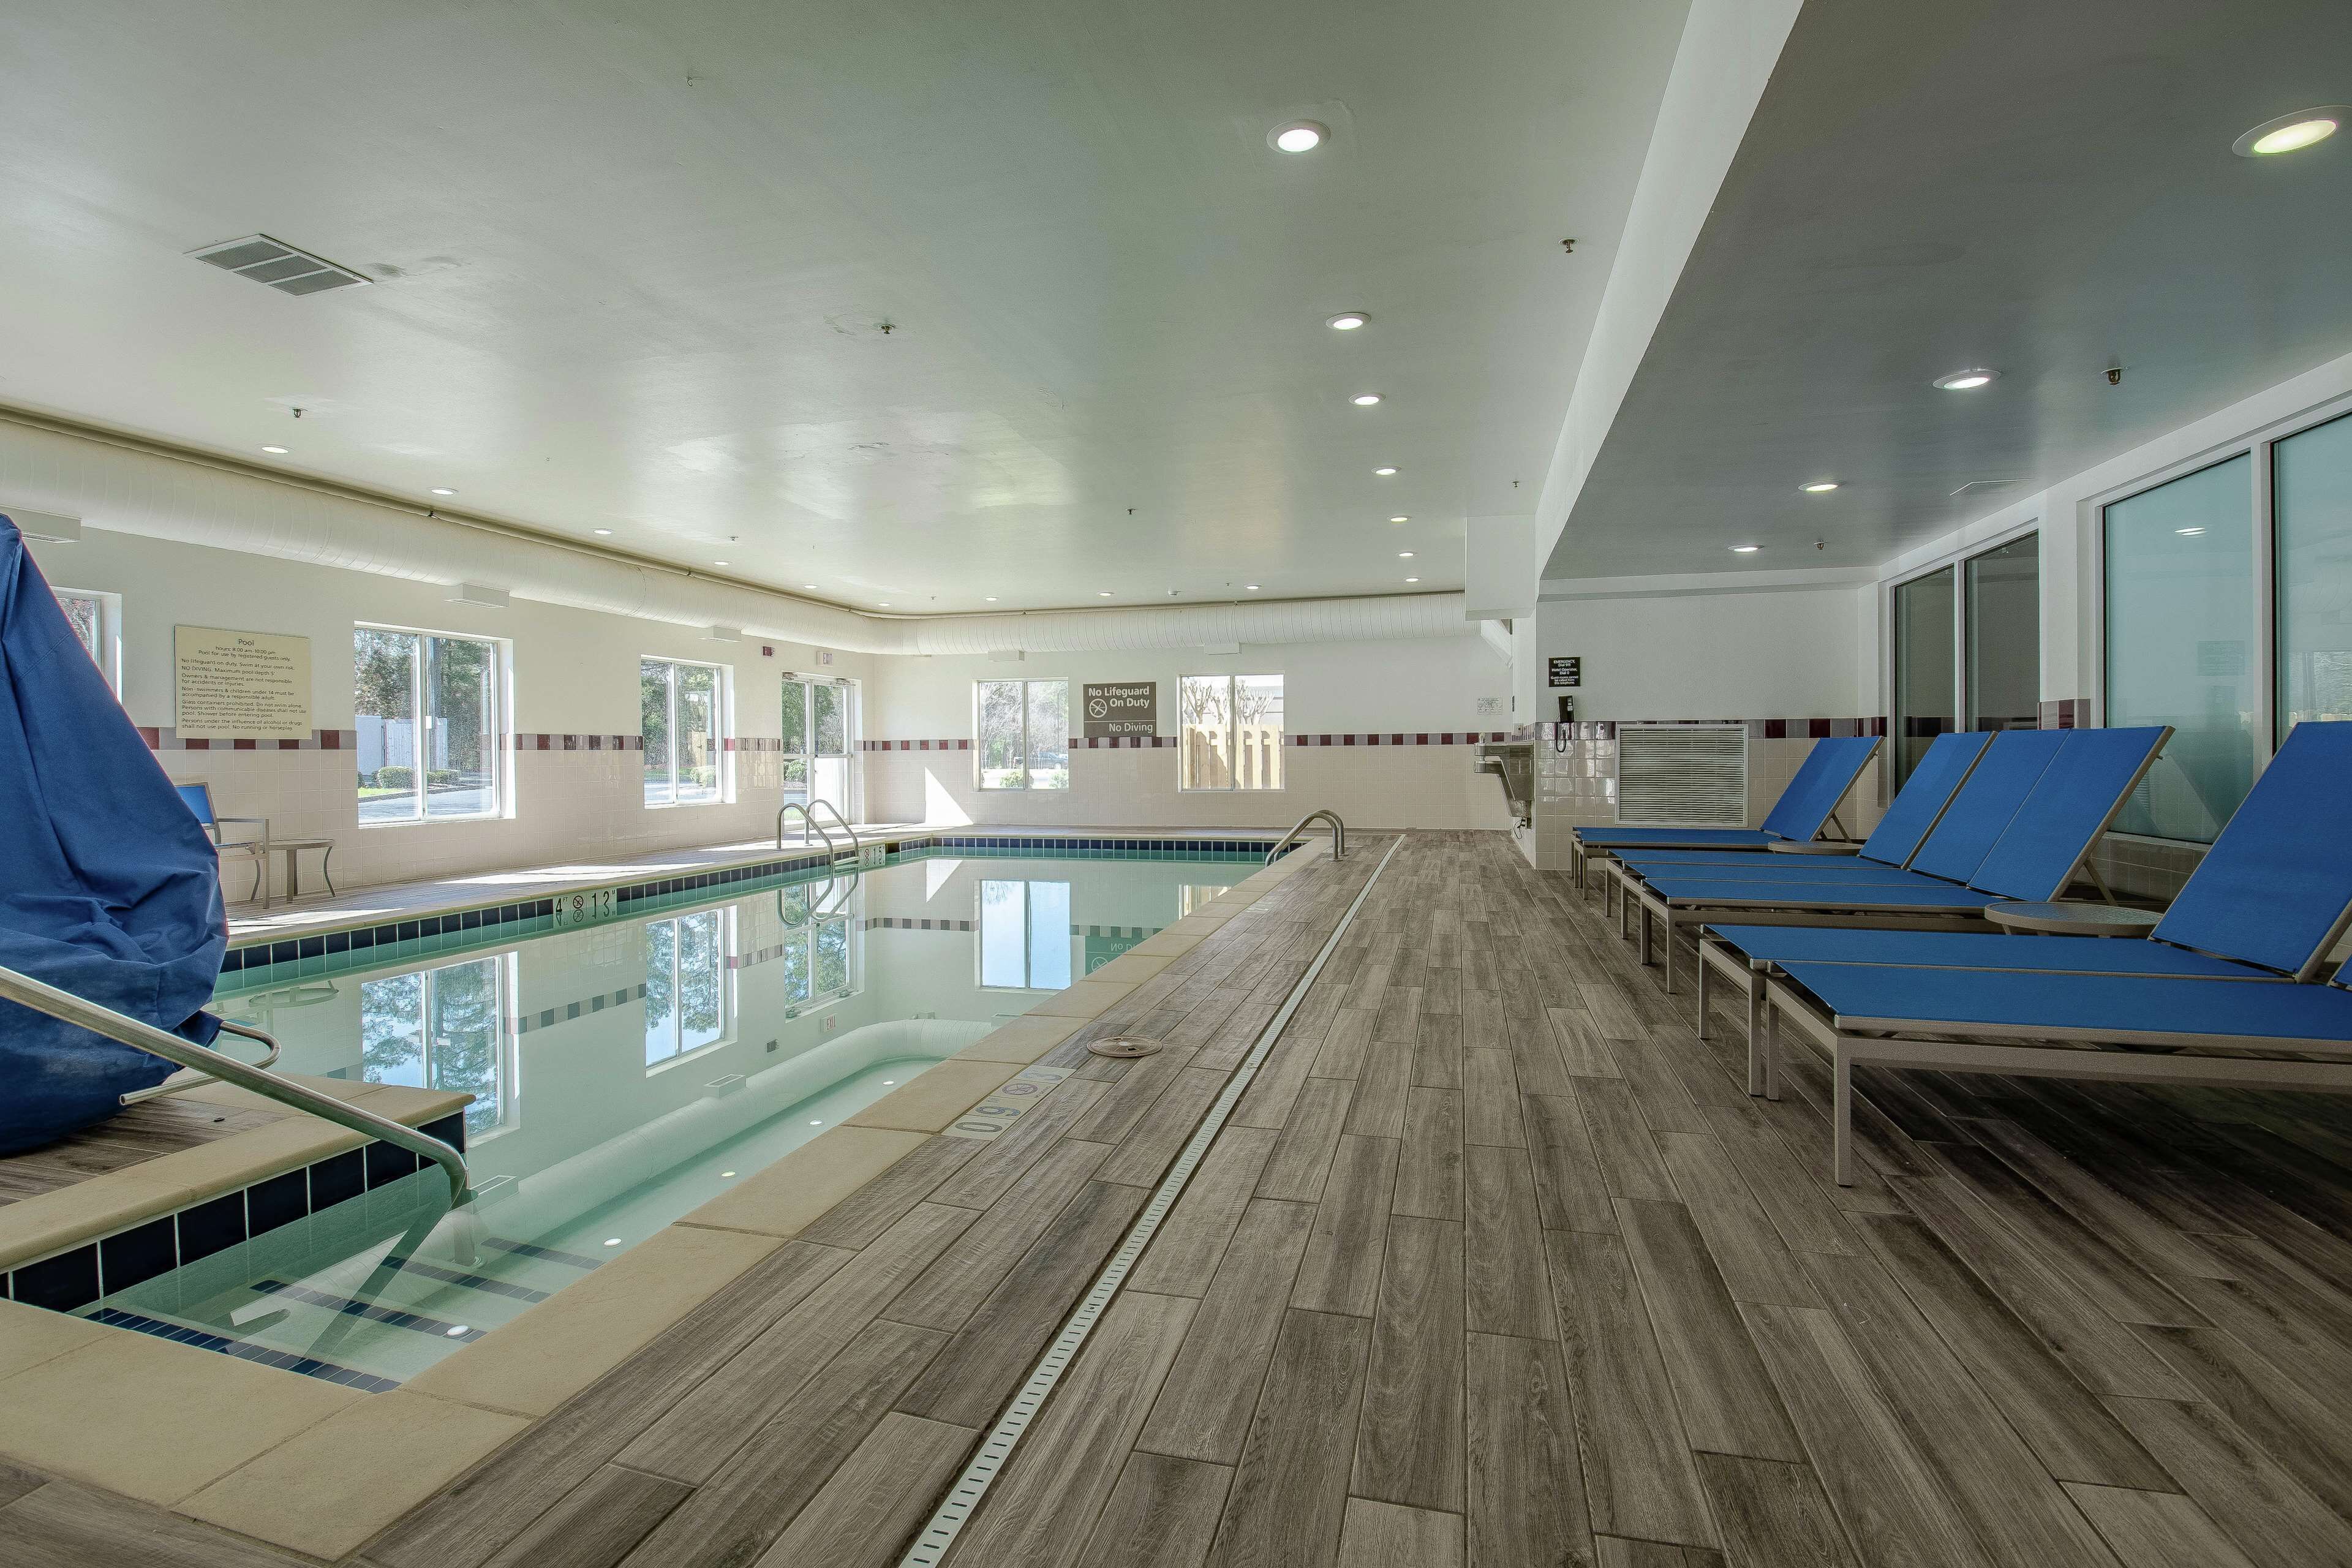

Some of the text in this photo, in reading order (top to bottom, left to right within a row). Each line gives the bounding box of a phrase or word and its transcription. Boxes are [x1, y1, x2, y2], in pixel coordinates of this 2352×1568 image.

[823, 652, 832, 666] EXIT
[1088, 685, 1150, 698] No Lifeguard
[1110, 698, 1150, 708] On Duty
[1109, 722, 1153, 733] No Diving
[556, 898, 562, 913] 4
